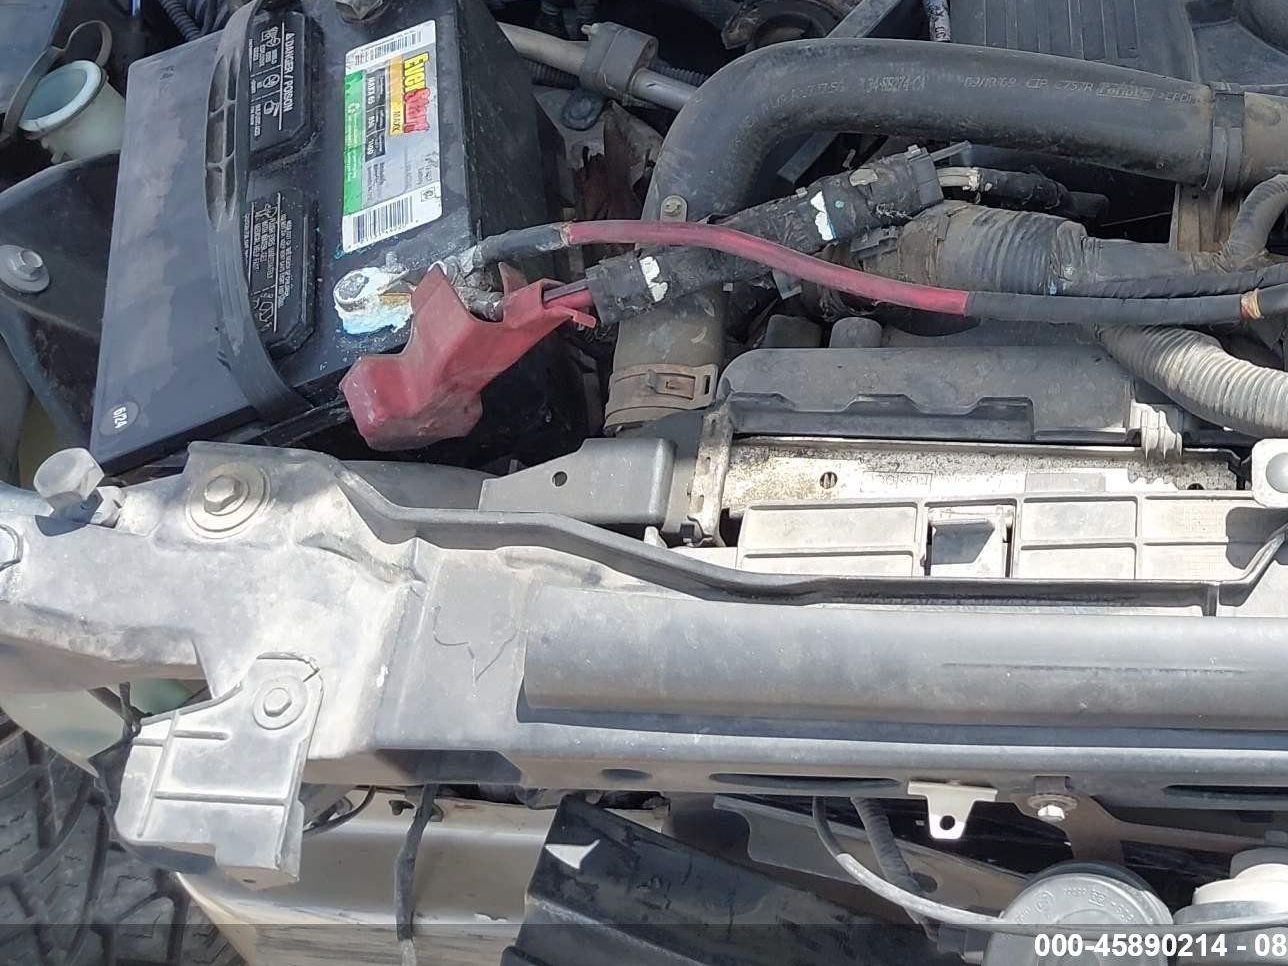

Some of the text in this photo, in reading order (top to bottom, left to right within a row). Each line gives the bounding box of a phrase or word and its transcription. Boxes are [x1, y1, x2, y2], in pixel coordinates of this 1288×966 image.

[284, 40, 294, 74] DANGER
[283, 80, 294, 113] POISON
[367, 77, 376, 96] MAXX
[403, 52, 430, 133] EverStart
[391, 111, 401, 133] MAXX
[112, 406, 128, 429] 6/24
